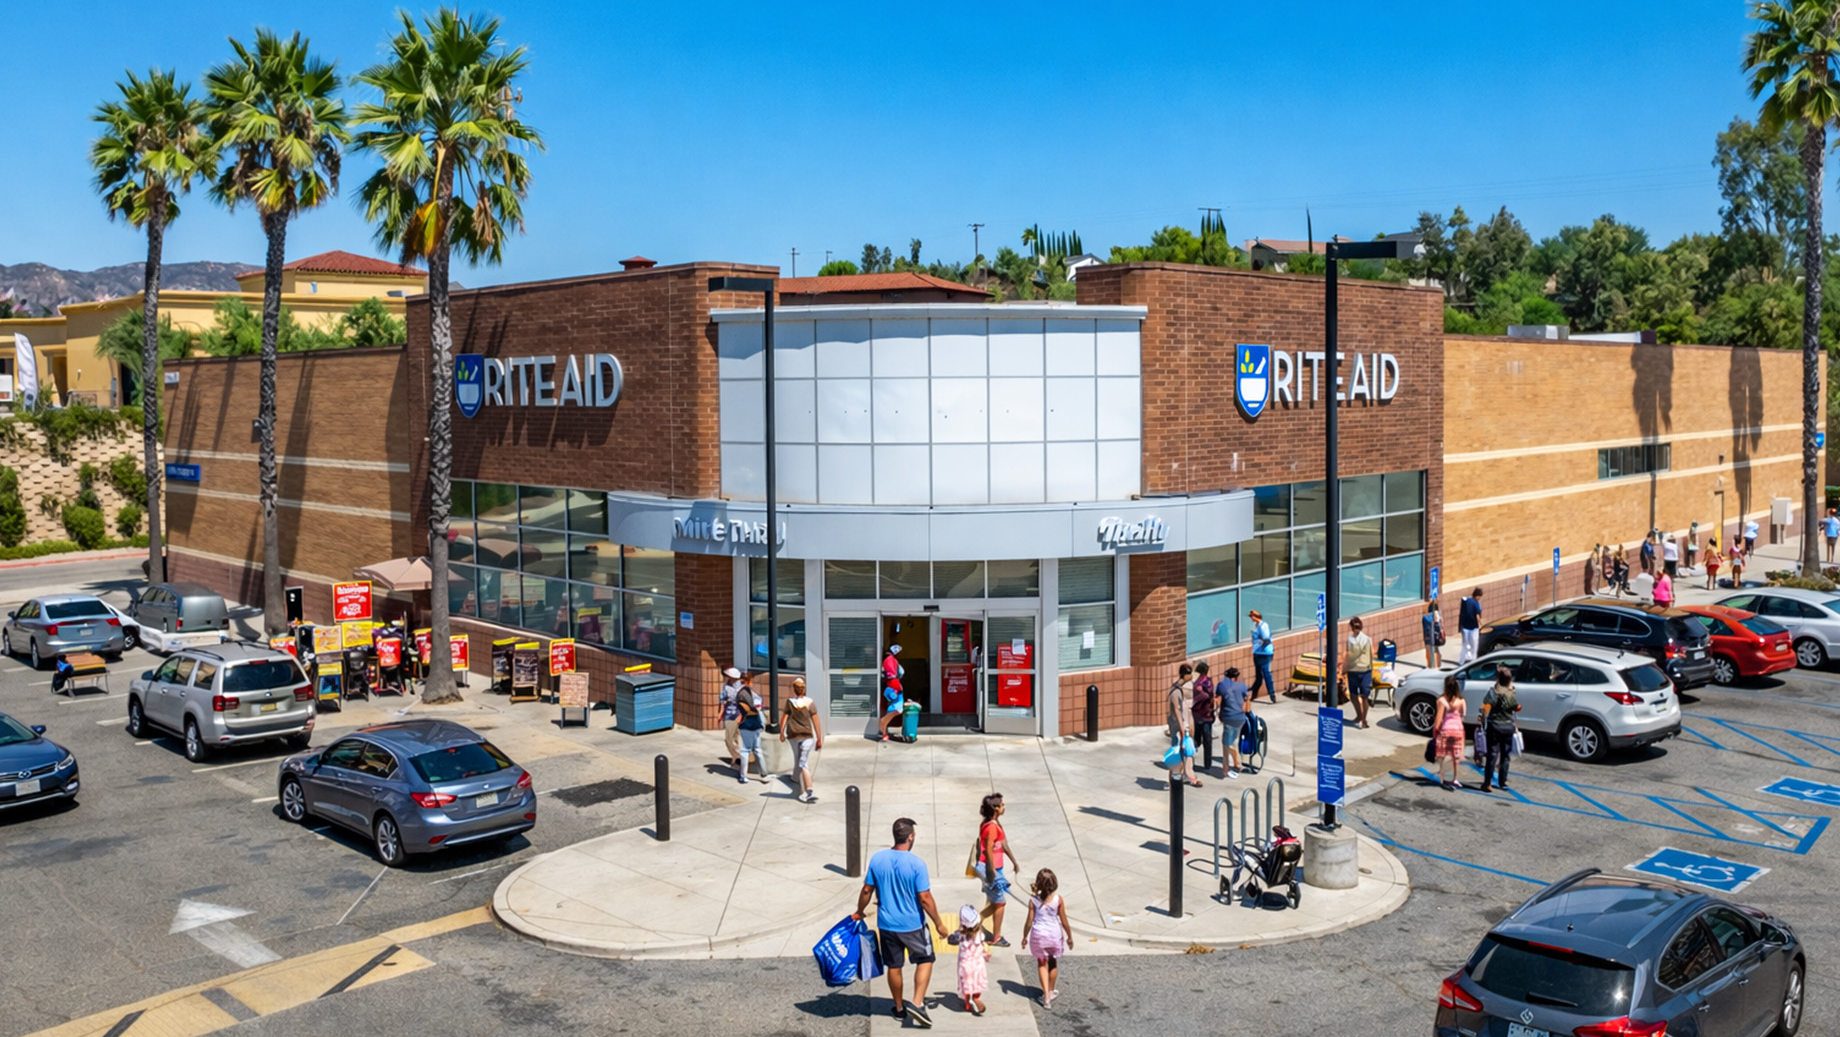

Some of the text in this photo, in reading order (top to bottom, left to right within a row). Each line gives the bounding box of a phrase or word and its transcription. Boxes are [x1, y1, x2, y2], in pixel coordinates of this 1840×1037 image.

[484, 354, 623, 407] RITE AID
[1350, 352, 1399, 401] AID
